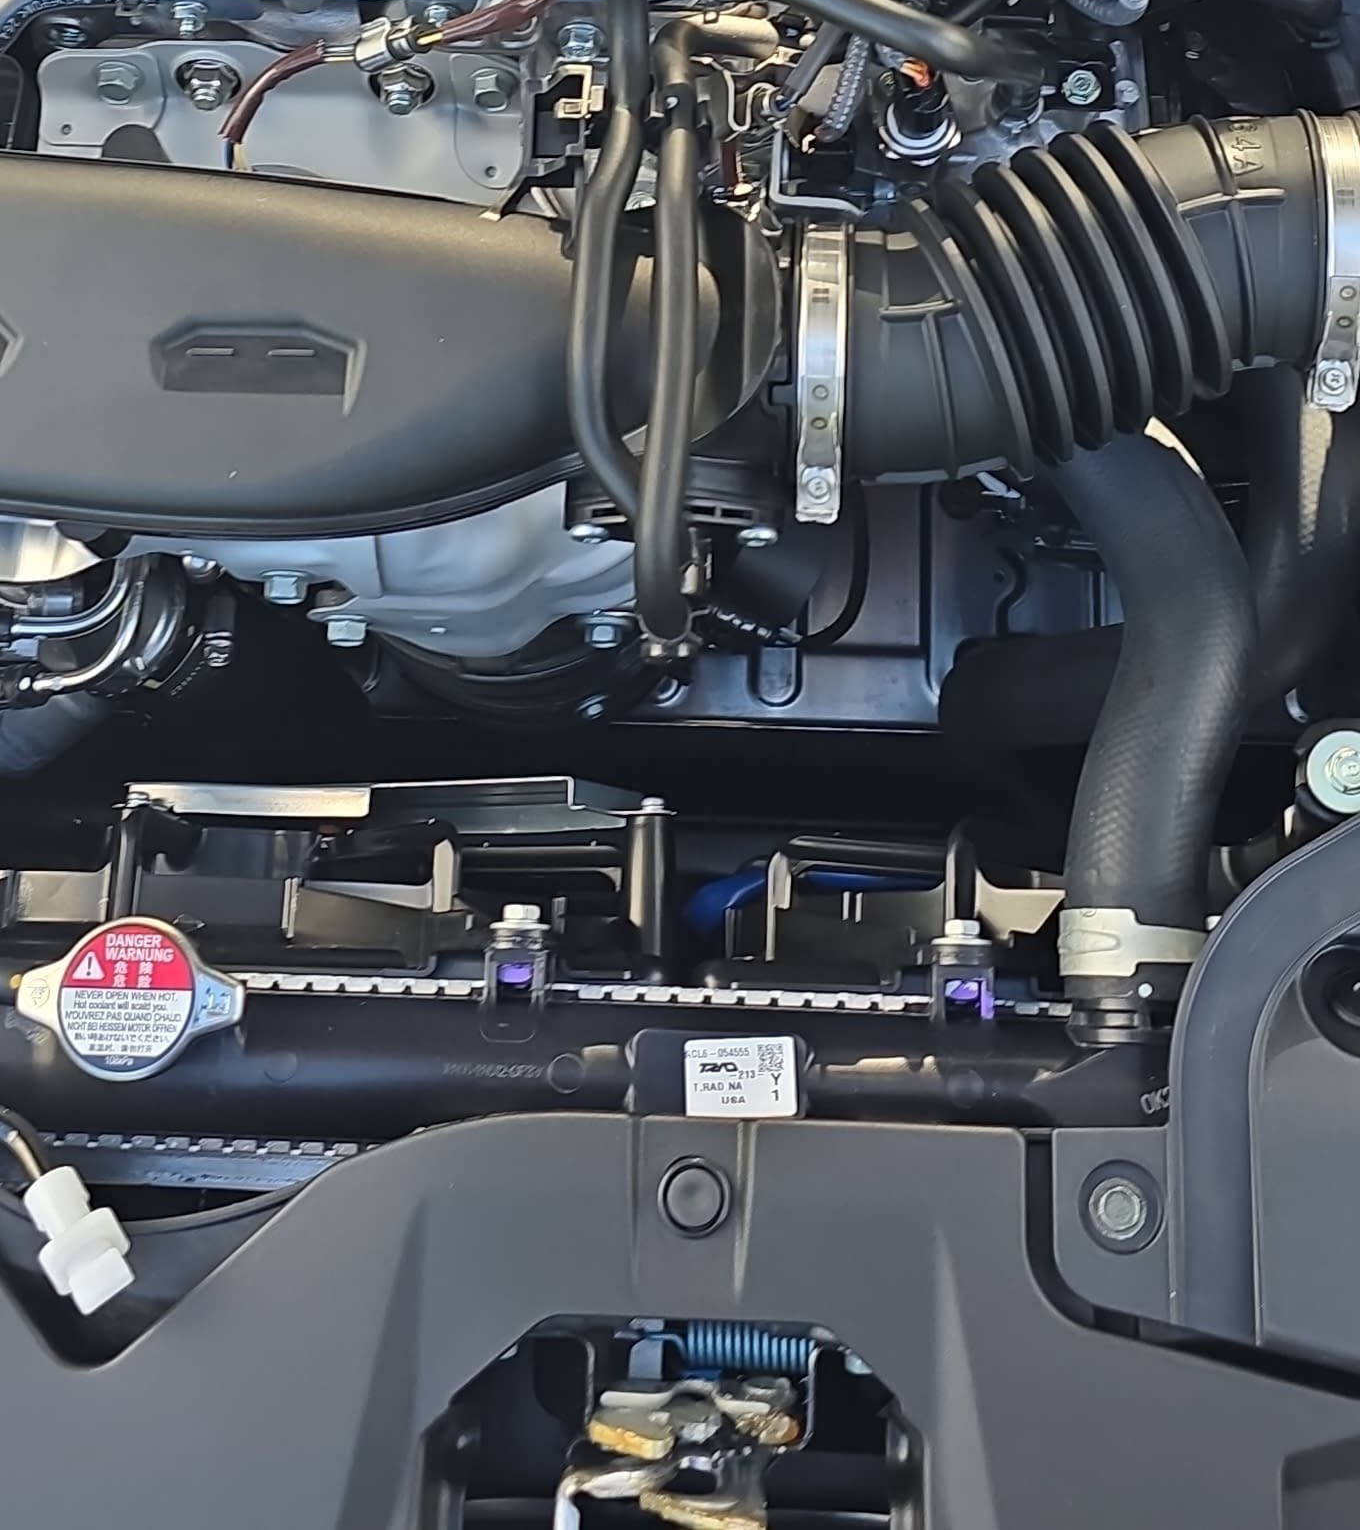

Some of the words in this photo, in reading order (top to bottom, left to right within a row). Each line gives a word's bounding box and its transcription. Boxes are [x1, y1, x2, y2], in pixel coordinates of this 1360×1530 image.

[105, 933, 162, 948] DANGER
[105, 948, 175, 963] WARNUNG
[74, 990, 104, 1001] NEVER
[105, 991, 130, 1001] OPEN
[131, 991, 157, 1002] WHEN
[73, 1000, 87, 1010] Hot
[89, 1000, 116, 1010] coolant
[117, 1001, 129, 1011] will
[106, 1011, 123, 1021] PAS
[124, 1011, 153, 1022] QUAND
[771, 1073, 781, 1085] Y
[693, 1081, 724, 1093] T.RAD
[728, 1081, 743, 1091] NA
[721, 1096, 746, 1104] USA
[771, 1089, 779, 1102] 1
